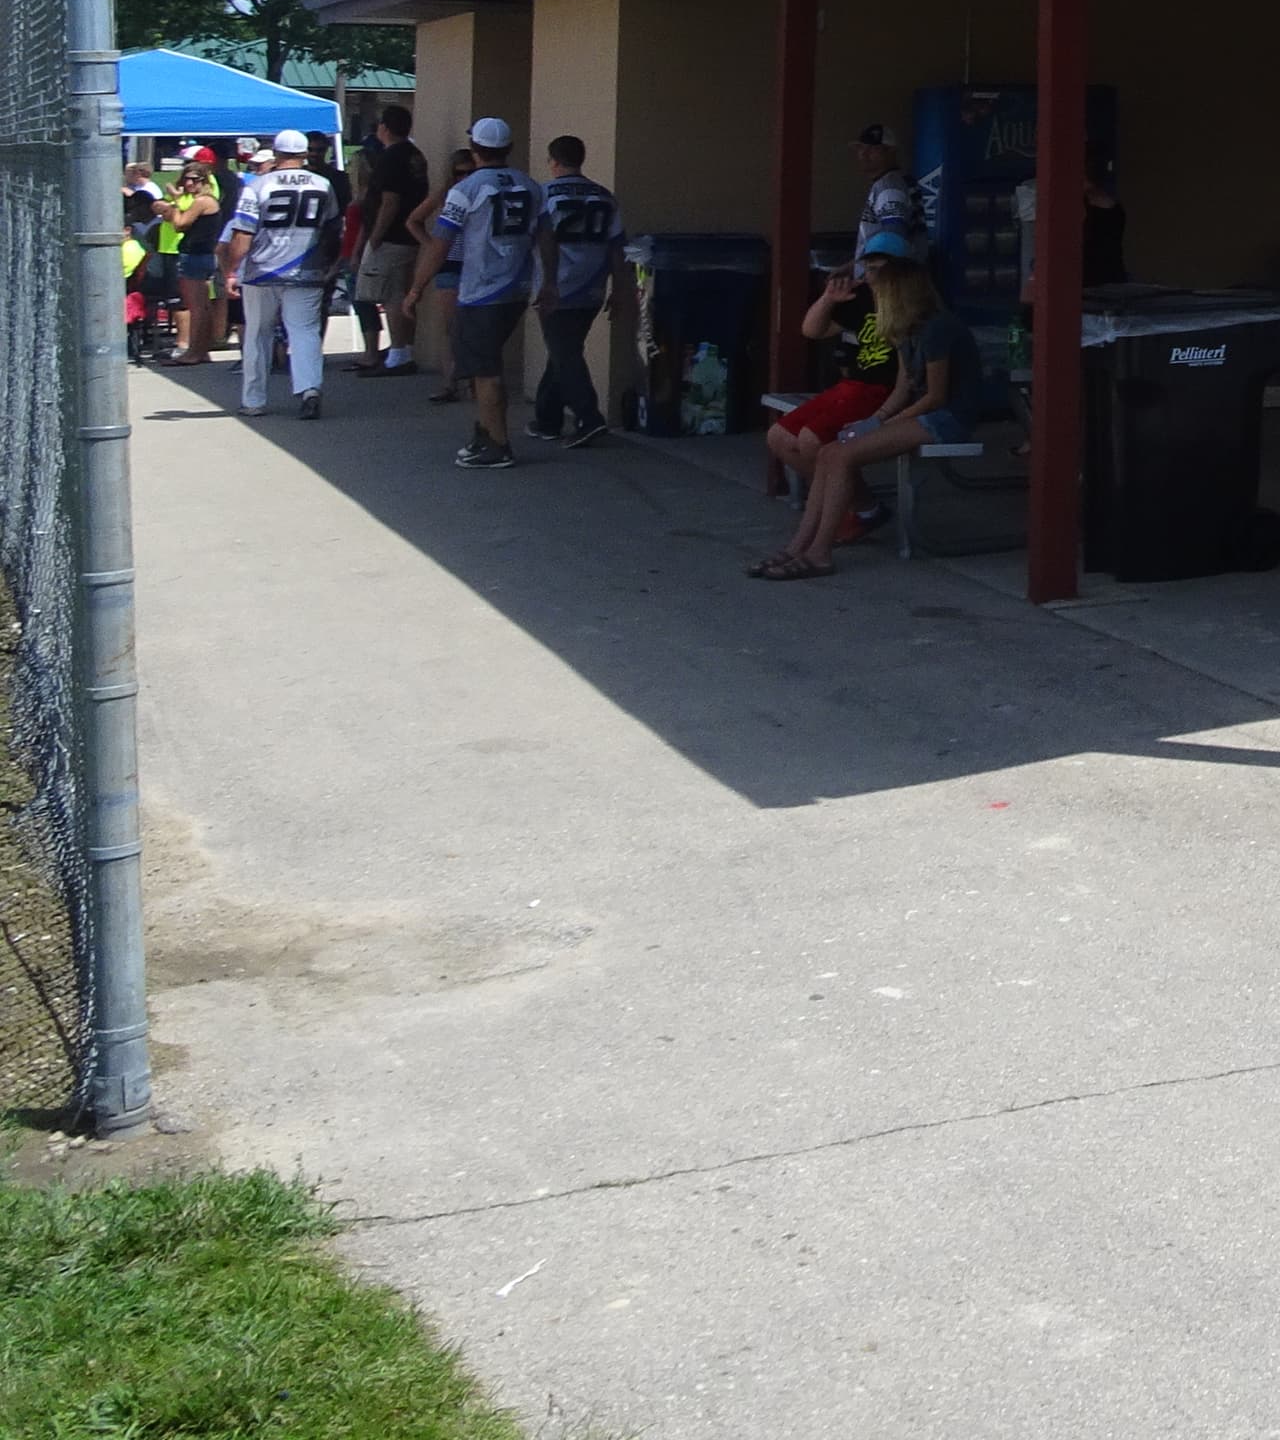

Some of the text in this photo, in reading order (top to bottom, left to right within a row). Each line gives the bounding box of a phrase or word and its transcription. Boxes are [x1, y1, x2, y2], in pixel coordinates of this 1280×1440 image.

[277, 174, 314, 185] MARK
[263, 189, 329, 228] 30
[488, 190, 532, 237] 13
[554, 199, 612, 242] 20
[1170, 344, 1226, 361] Pellitteri
